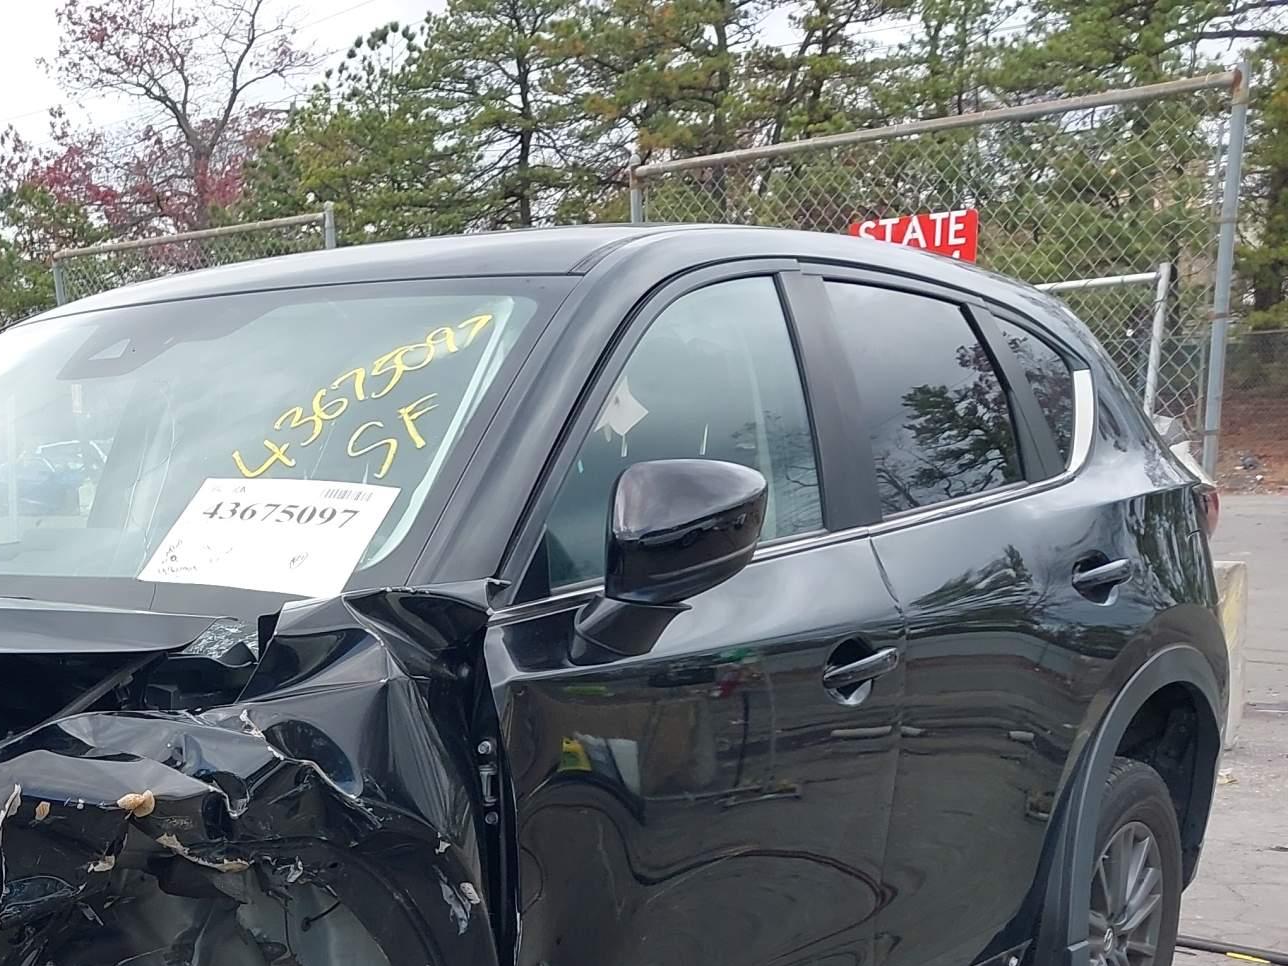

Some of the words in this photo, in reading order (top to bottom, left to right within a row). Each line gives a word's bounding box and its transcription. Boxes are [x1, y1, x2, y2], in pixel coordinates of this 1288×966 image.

[858, 209, 967, 249] STATE
[231, 313, 493, 479] 43675097
[347, 392, 440, 479] SF
[202, 501, 360, 529] 43675097
